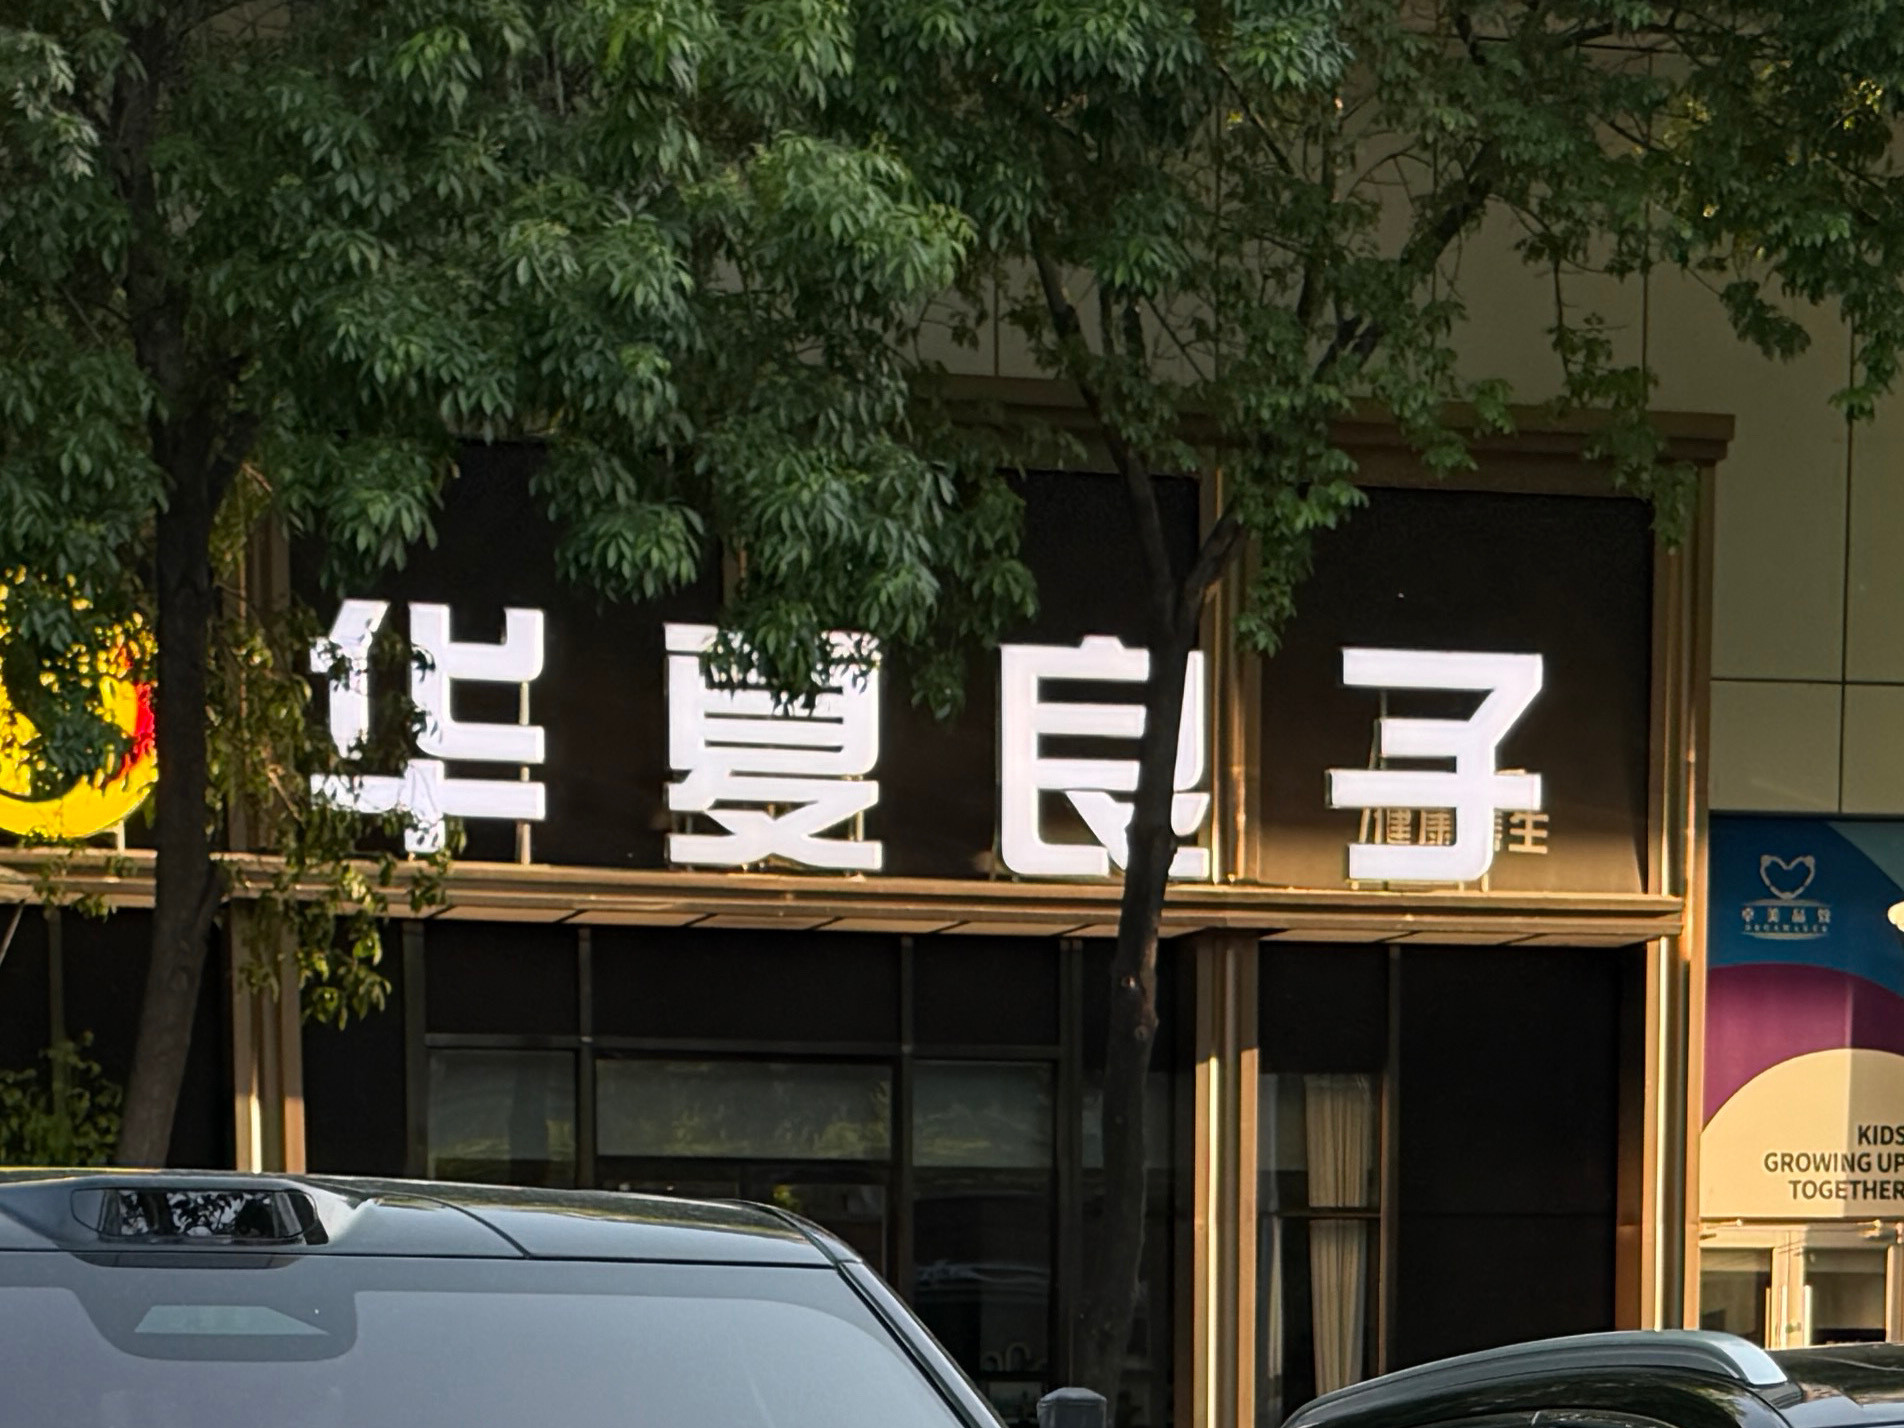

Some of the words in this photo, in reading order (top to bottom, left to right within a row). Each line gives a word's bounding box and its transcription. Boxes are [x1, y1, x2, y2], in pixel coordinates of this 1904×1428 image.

[309, 599, 1543, 880] 华夏良子
[1764, 1152, 1872, 1173] GROWING
